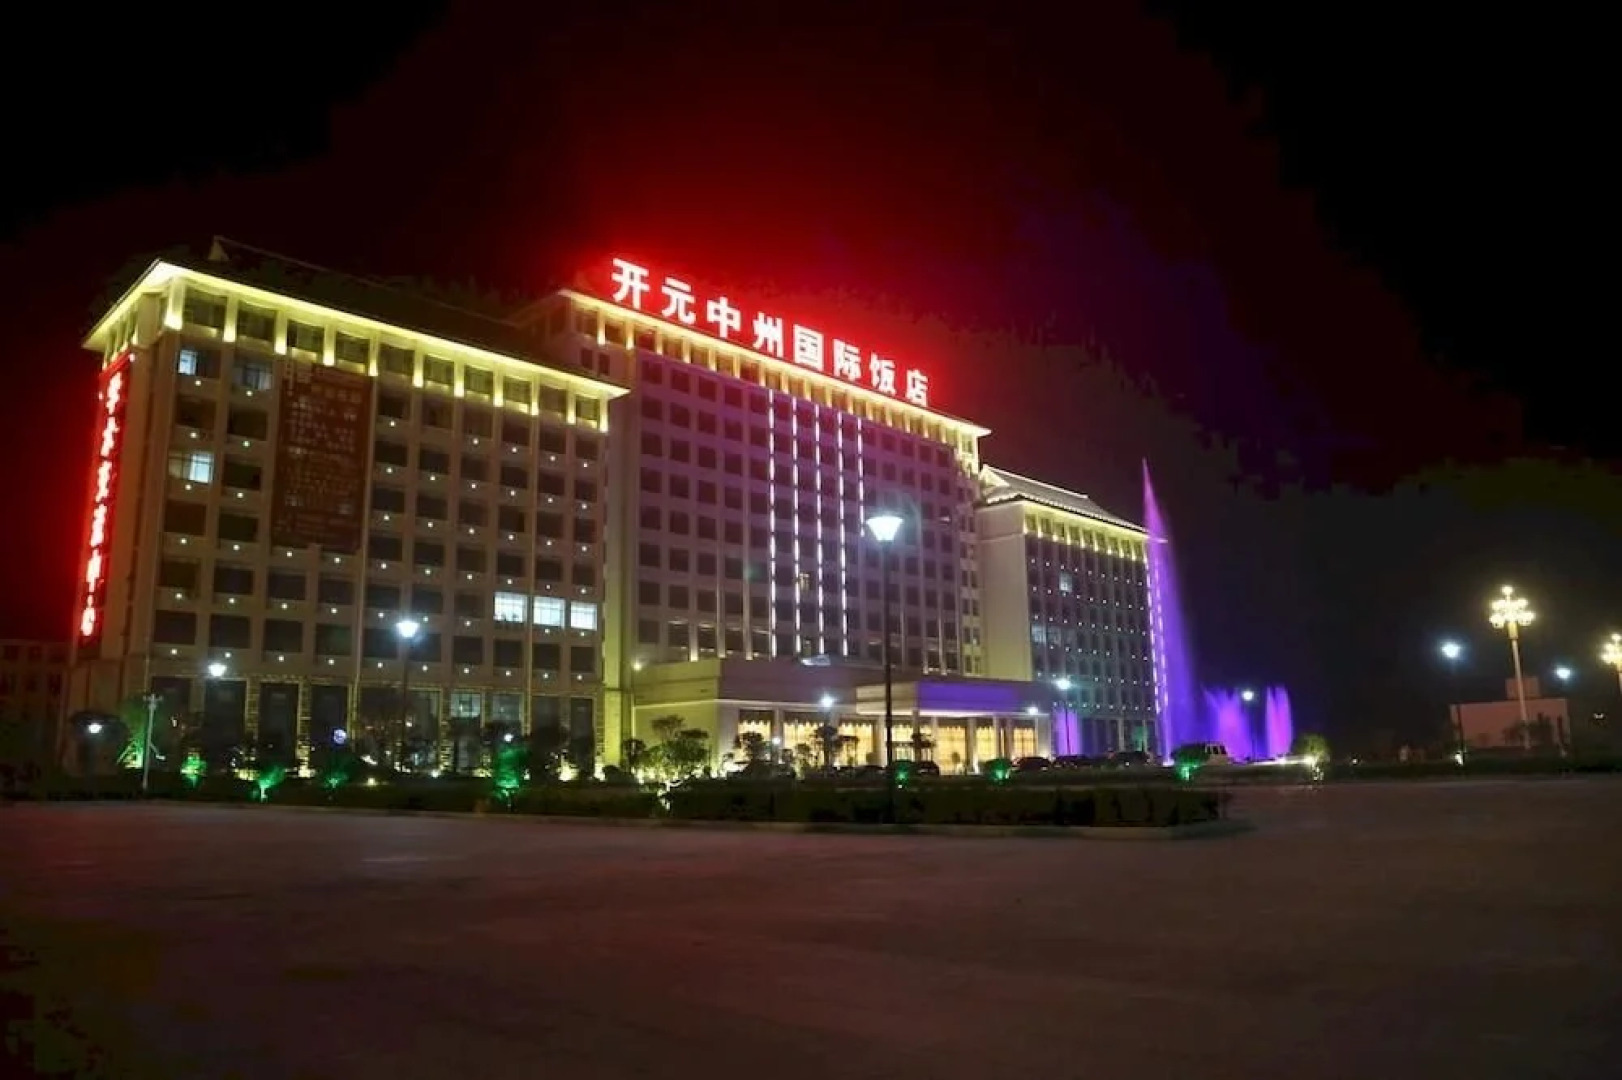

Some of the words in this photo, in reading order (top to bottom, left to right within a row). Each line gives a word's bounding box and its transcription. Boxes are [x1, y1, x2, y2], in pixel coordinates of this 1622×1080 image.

[611, 258, 929, 407] 开元中州国际饭店
